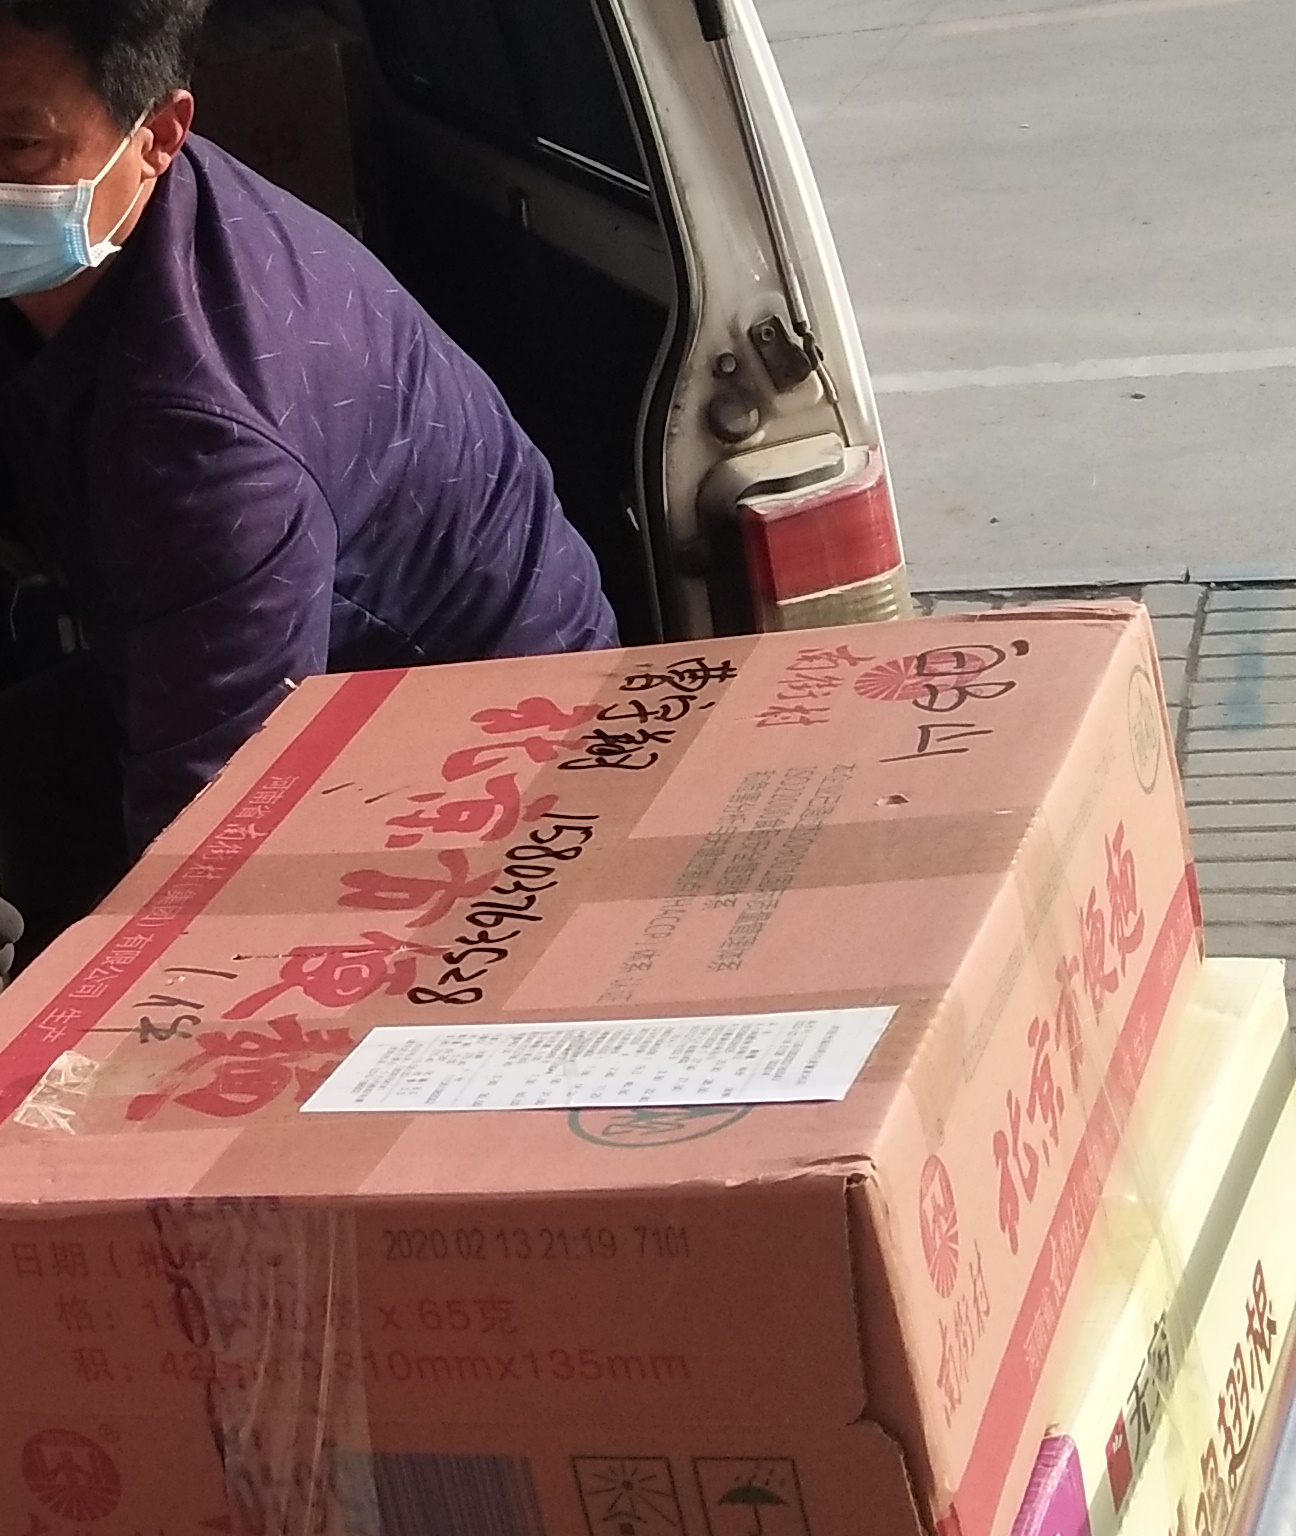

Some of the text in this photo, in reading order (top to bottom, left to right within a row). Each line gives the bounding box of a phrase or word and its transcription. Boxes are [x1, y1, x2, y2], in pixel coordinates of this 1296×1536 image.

[382, 1227, 449, 1261] 2020
[455, 1226, 486, 1261] 02
[495, 1227, 533, 1260] 13
